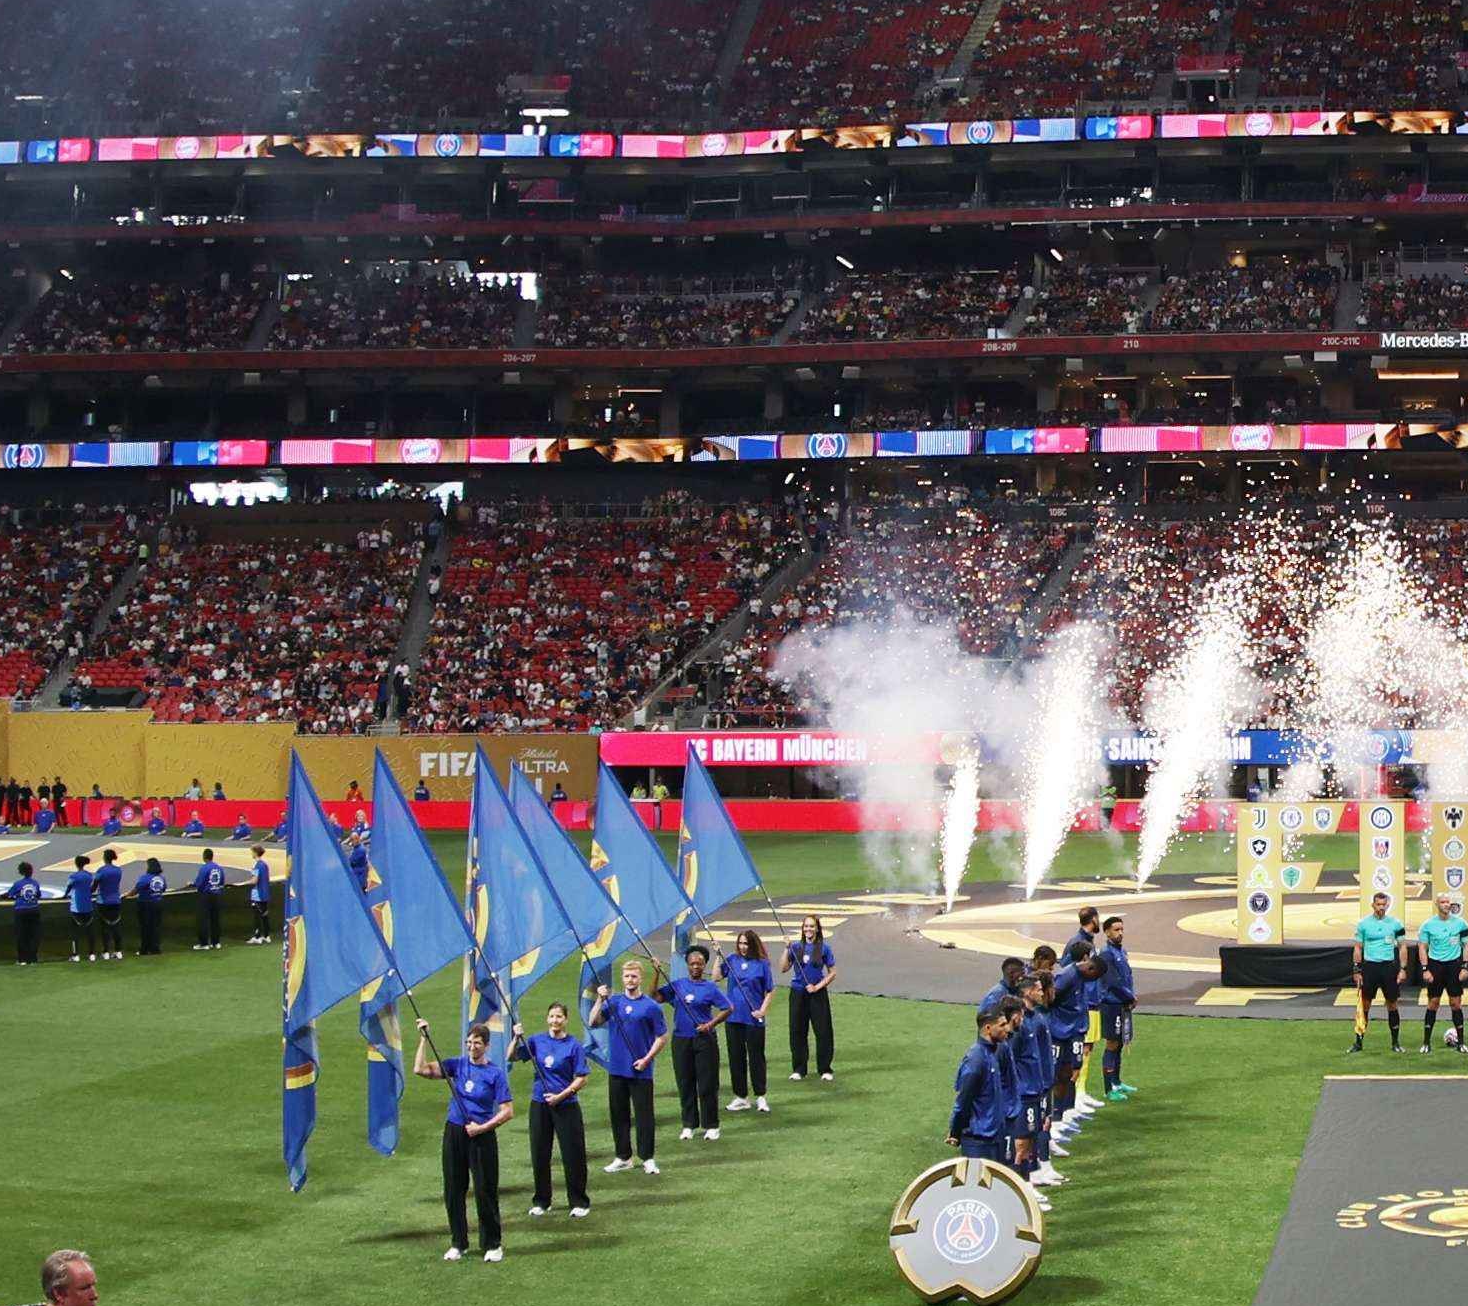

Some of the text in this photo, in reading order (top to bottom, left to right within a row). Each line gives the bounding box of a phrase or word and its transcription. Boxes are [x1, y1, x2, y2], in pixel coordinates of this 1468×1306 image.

[712, 738, 777, 762] BAYERN
[781, 734, 866, 762] MÜNCHEN
[1027, 1107, 1035, 1123] 8
[946, 1200, 993, 1219] PARIS
